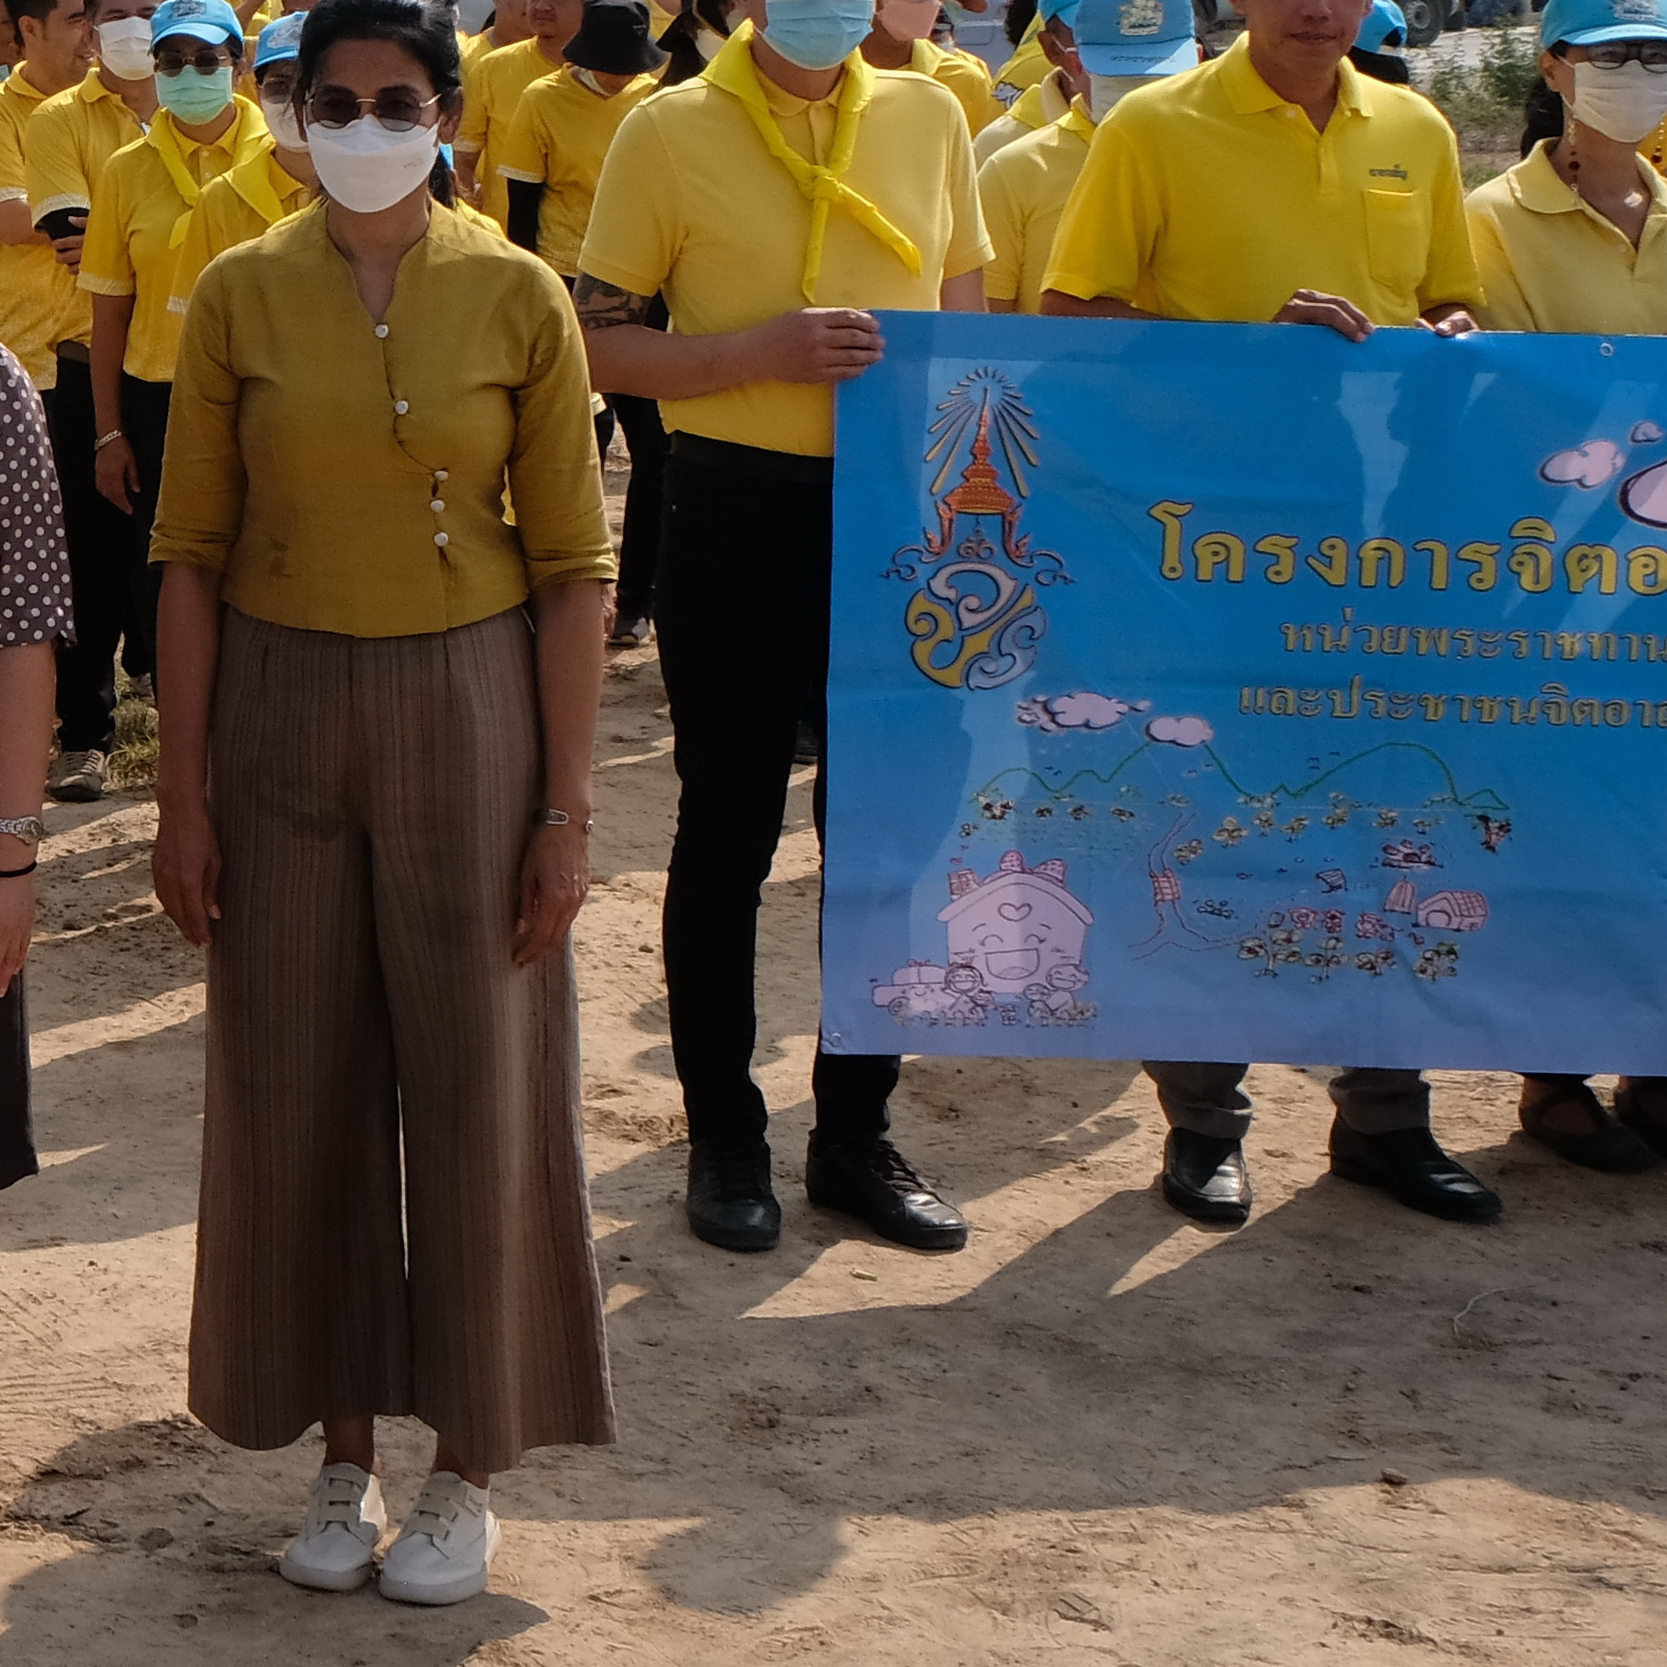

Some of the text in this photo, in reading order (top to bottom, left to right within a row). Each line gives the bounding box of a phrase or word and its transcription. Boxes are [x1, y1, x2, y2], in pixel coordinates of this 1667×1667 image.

[1147, 499, 1667, 596] โครงการจิตอ
